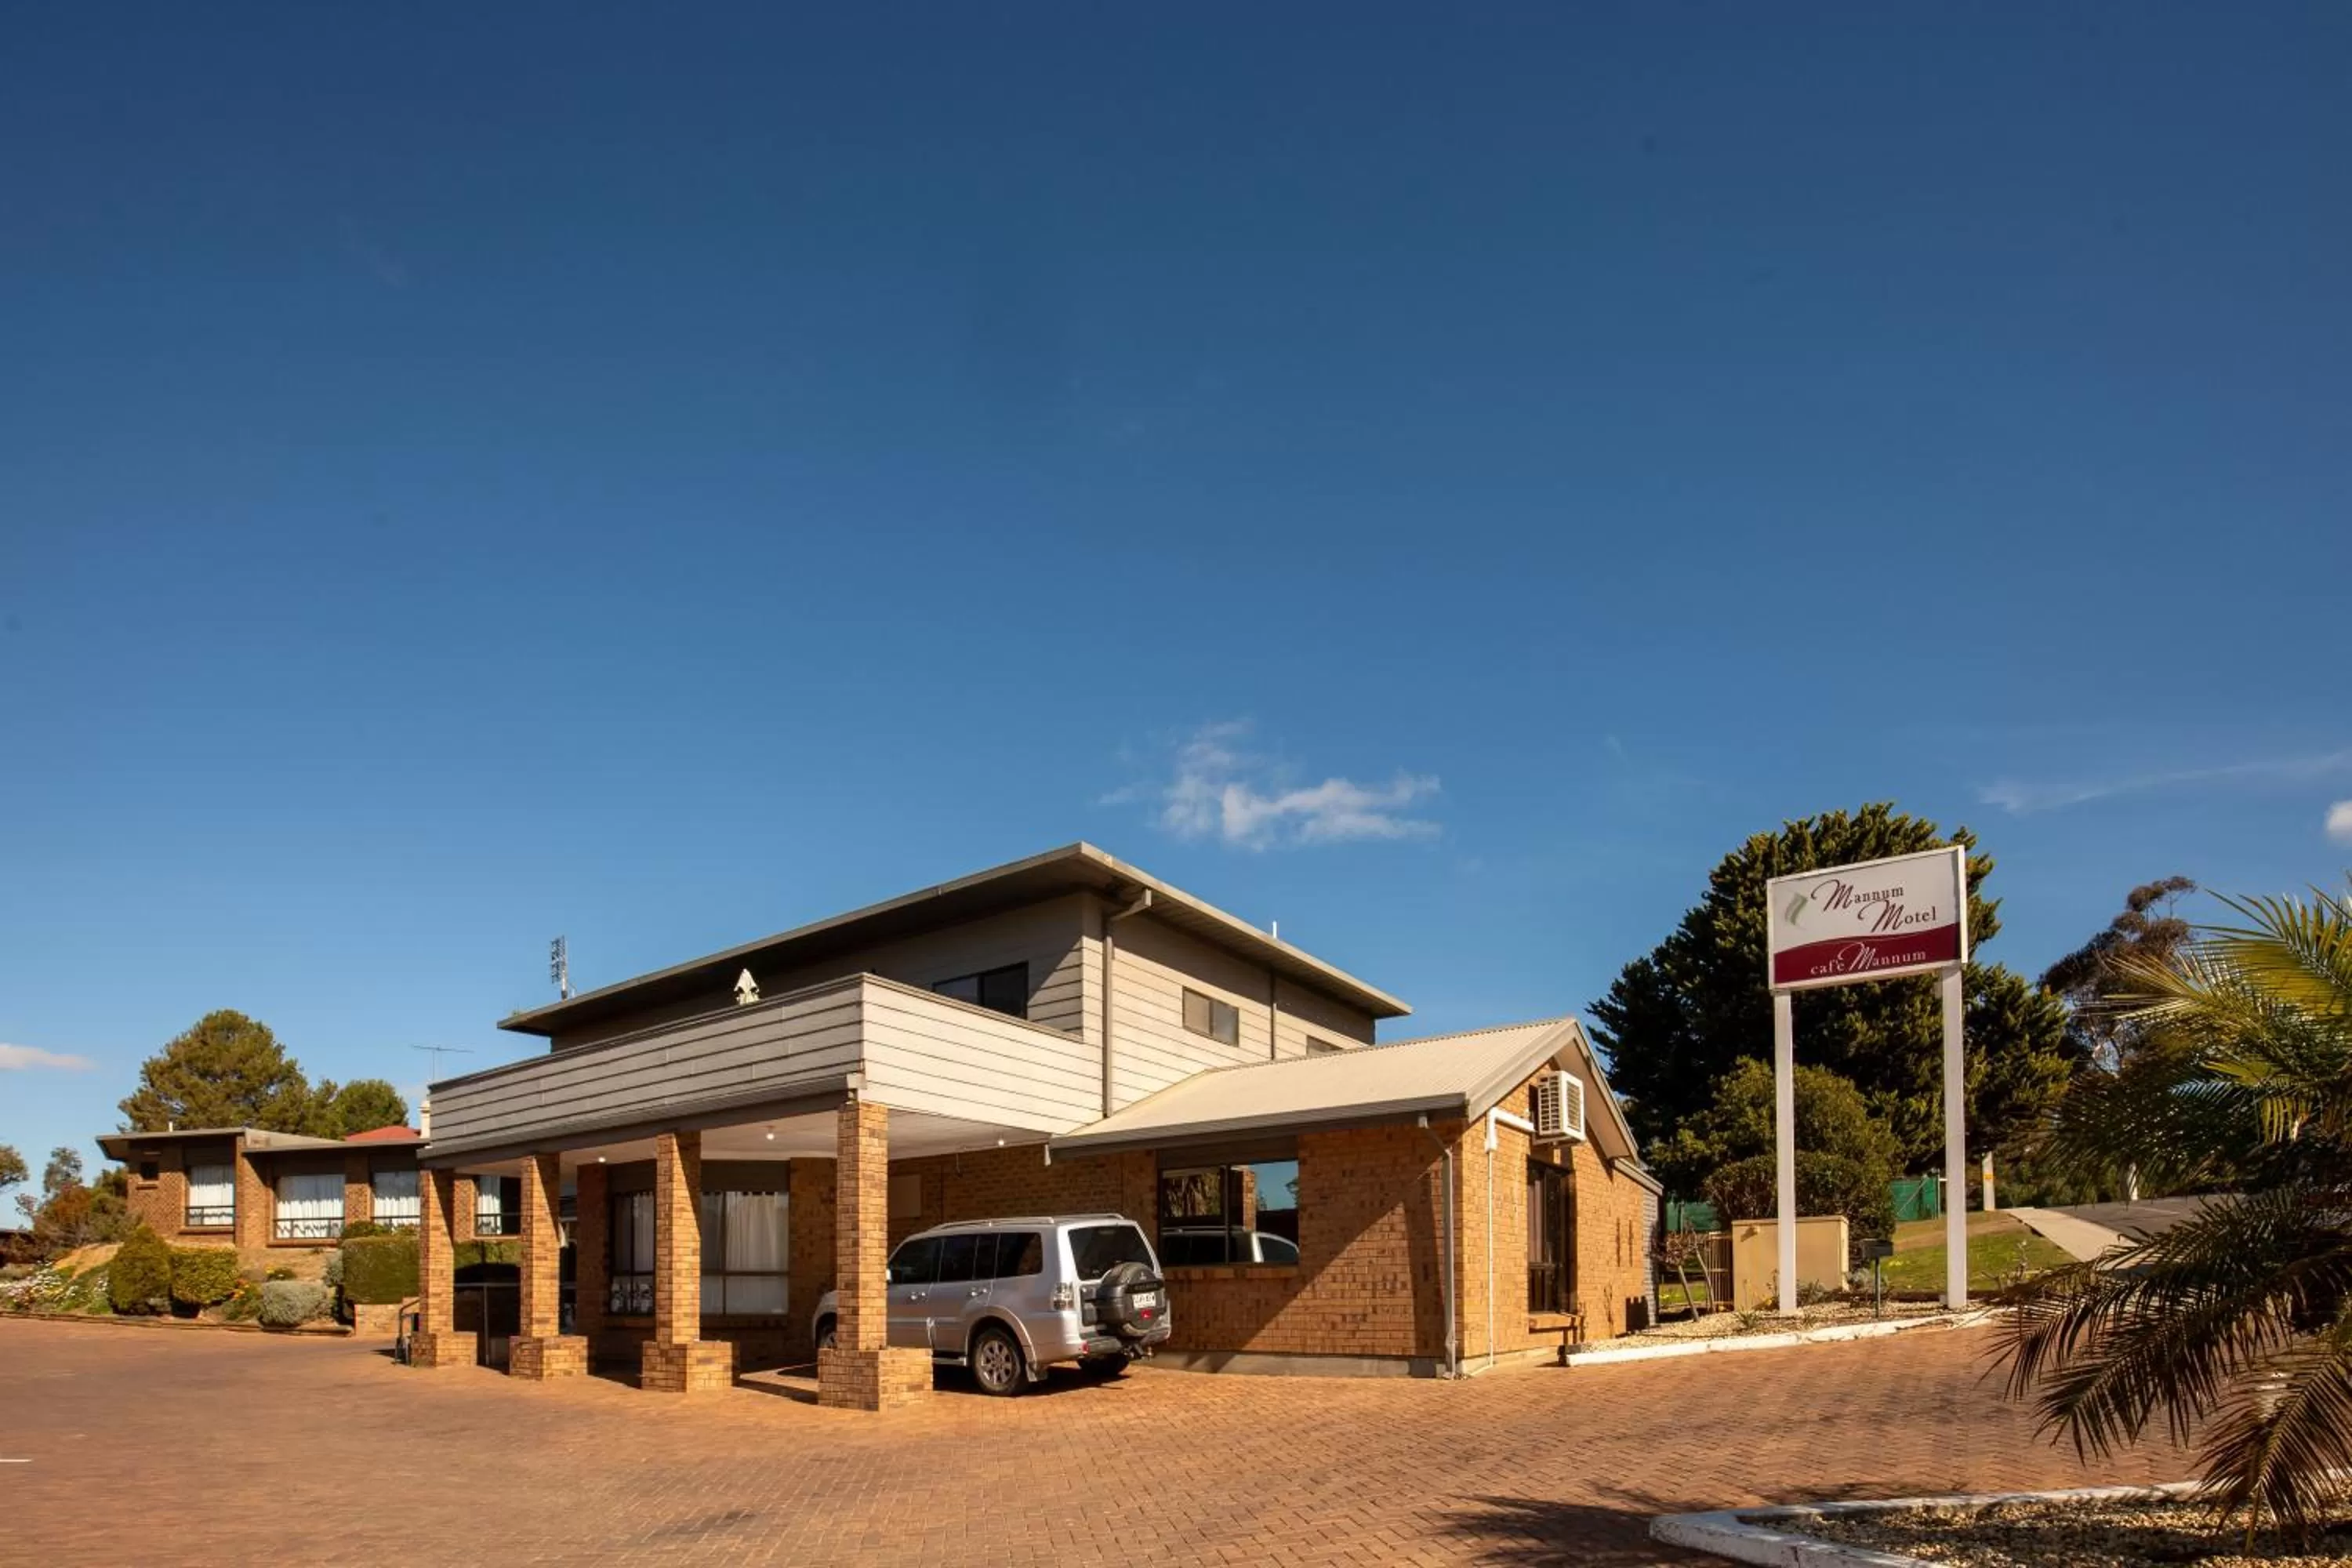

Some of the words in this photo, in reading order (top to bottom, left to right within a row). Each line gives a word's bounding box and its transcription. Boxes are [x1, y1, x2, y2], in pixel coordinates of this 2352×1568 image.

[1810, 879, 1904, 912] Mannum
[1857, 901, 1936, 933] Motel
[1837, 942, 1926, 971] Mannum
